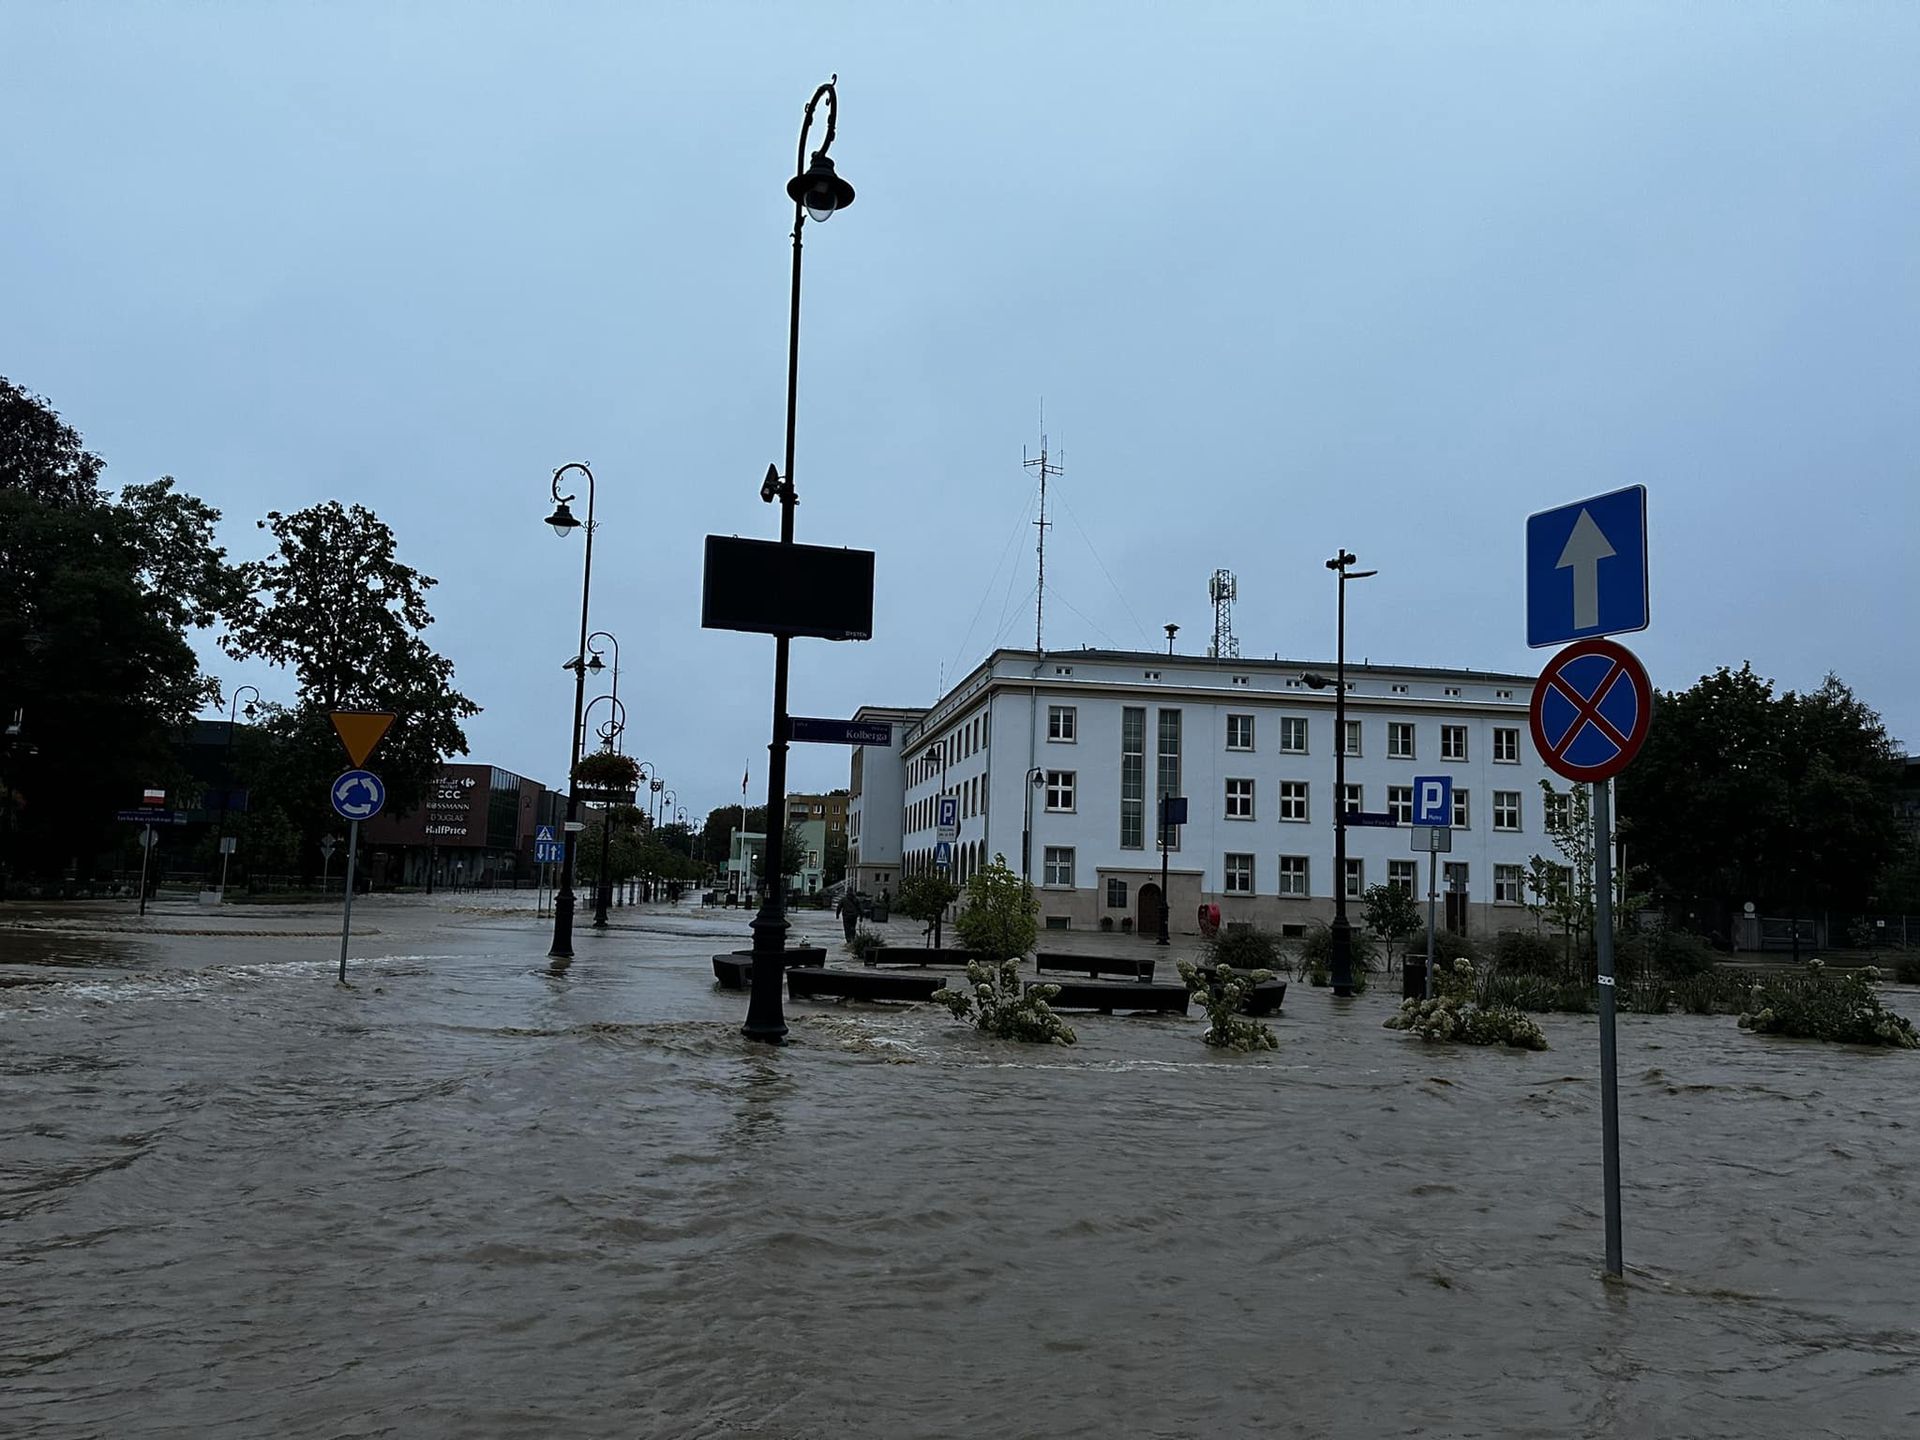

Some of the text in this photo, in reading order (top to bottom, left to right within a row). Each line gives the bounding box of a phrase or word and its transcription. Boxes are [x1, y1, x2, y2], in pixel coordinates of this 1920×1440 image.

[846, 729, 888, 742] Kolberga
[438, 790, 461, 799] CCC
[1421, 782, 1443, 819] P
[426, 802, 469, 810] ROSSMANN
[430, 813, 464, 822] DOUGLAS
